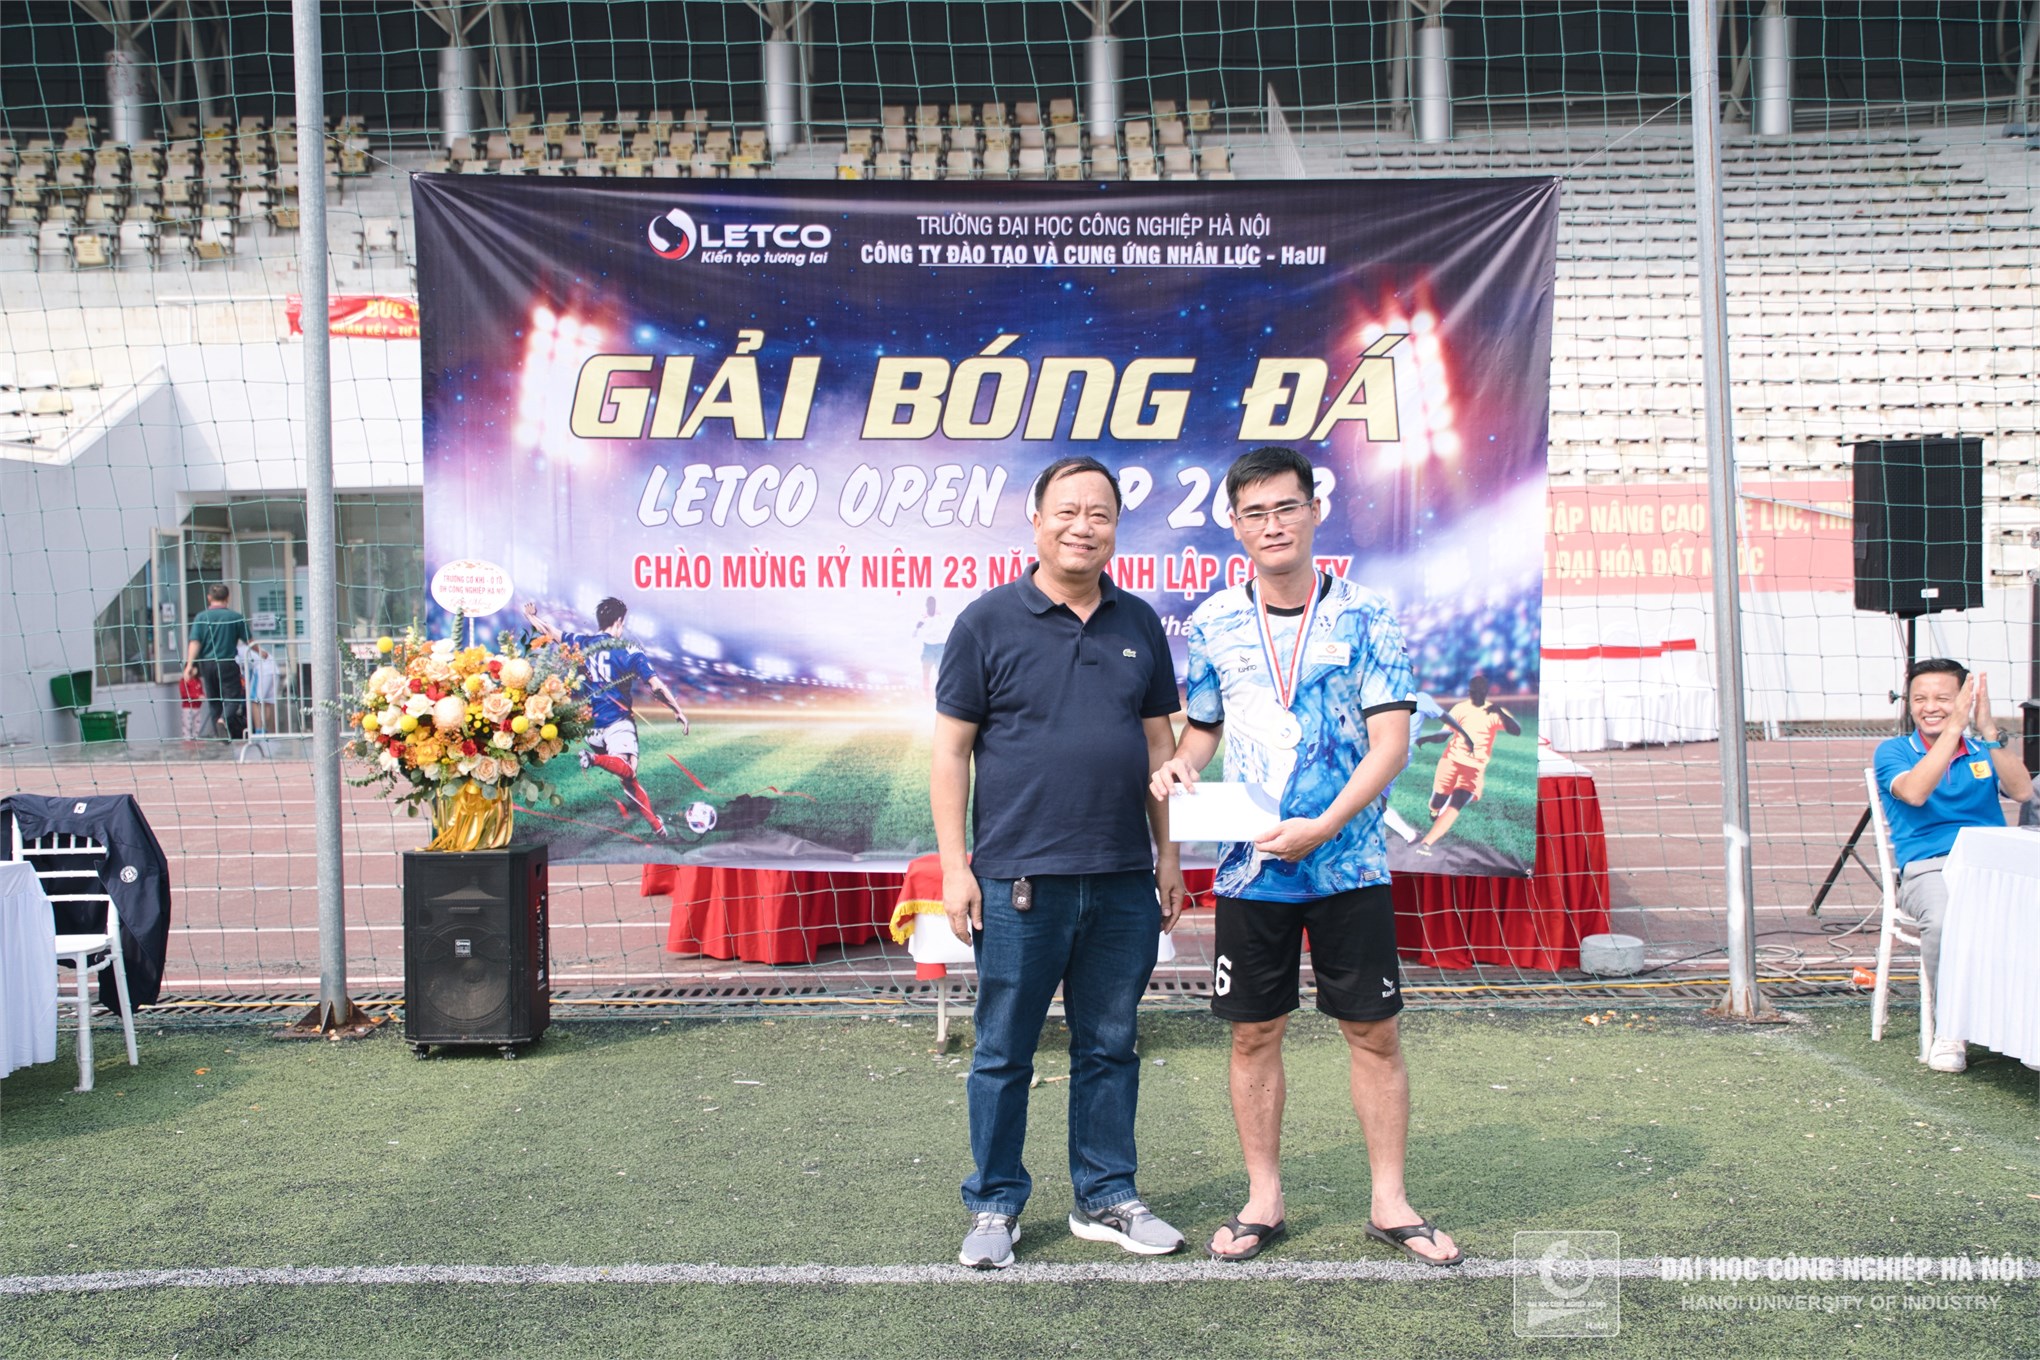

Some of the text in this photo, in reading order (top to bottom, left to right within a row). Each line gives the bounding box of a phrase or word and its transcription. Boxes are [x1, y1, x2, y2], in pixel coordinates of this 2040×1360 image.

[700, 225, 832, 249] LETCO
[917, 212, 1270, 239] TRƯỜNG ĐẠI HỌC CÔNG NGHIỆP HÀ NỘI
[700, 249, 828, 267] Kiến tạo tương lai
[861, 240, 913, 264] CÔNG
[919, 244, 942, 264] TY
[946, 241, 986, 264] ĐÀO
[991, 244, 1028, 268] TẠO
[1033, 241, 1058, 264] VÀ
[1064, 244, 1116, 265] CUNG
[1122, 241, 1161, 265] ỨNG
[1167, 241, 1218, 265] NHÂN
[1224, 243, 1261, 268] LỰC
[1281, 246, 1326, 265] HaUI
[570, 329, 1409, 443] GIẢI BÓNG ĐÁ
[637, 463, 818, 528] LETCO
[839, 463, 1008, 529] OPEN
[1590, 499, 1654, 534] NÂNG
[1661, 503, 1706, 534] CAO
[634, 547, 711, 589] CHÀO
[723, 547, 806, 589] MỪNG
[818, 545, 851, 588] KỶ
[862, 548, 931, 596] NIỆM
[943, 556, 977, 589] 23
[989, 549, 1036, 589] NĂ
[1166, 548, 1217, 598] LẬP
[1555, 550, 1594, 585] ĐẠI
[1600, 543, 1646, 578] HÓA
[1652, 537, 1695, 577] ĐẤT
[1215, 954, 1232, 997] 6
